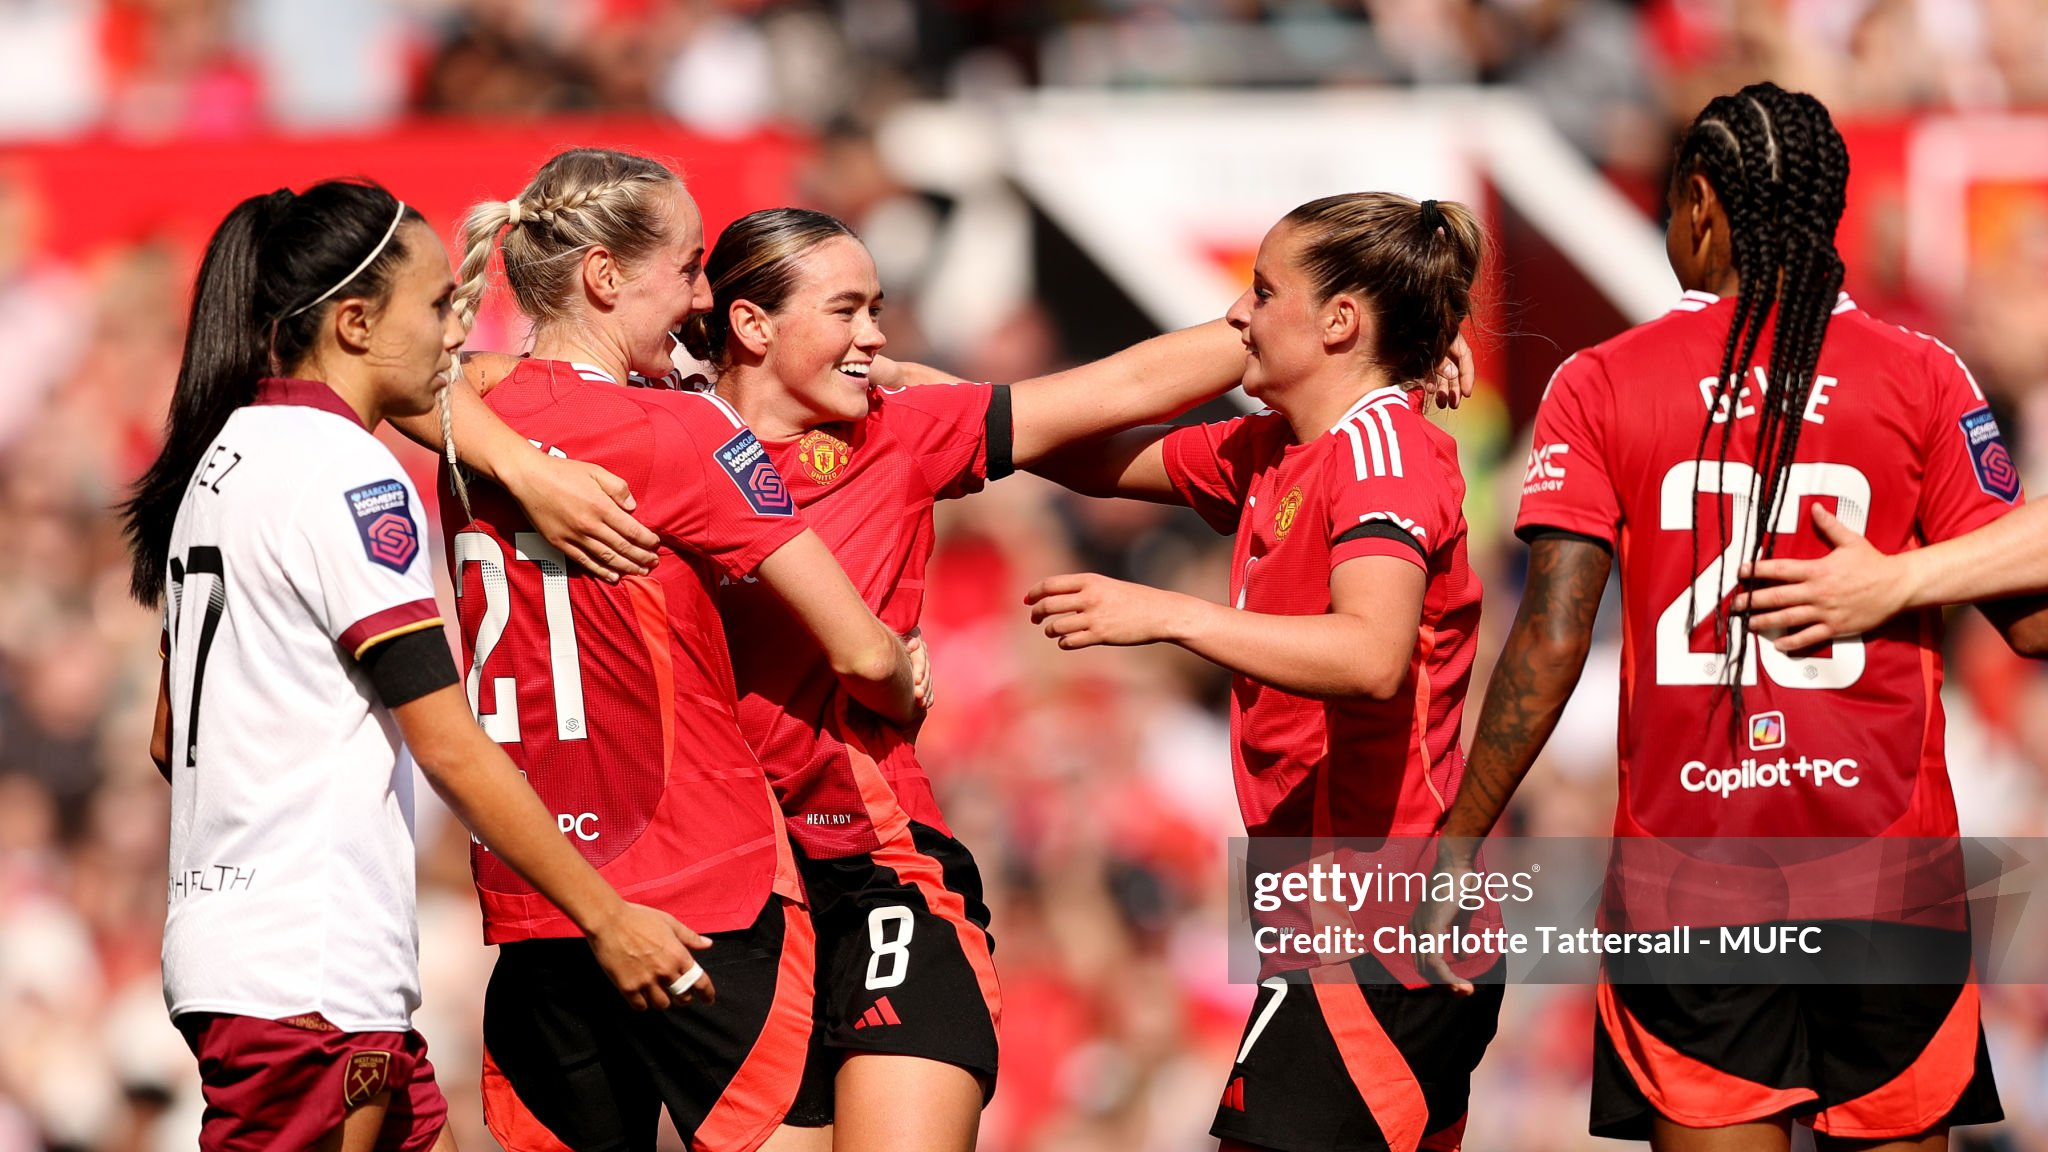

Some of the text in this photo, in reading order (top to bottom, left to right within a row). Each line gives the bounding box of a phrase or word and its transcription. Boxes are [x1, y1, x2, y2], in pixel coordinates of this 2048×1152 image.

[198, 445, 242, 495] EZ
[454, 532, 588, 743] 21
[1680, 755, 1860, 799] Copilot+PC
[865, 905, 914, 991] 8
[1236, 977, 1288, 1064] 7
